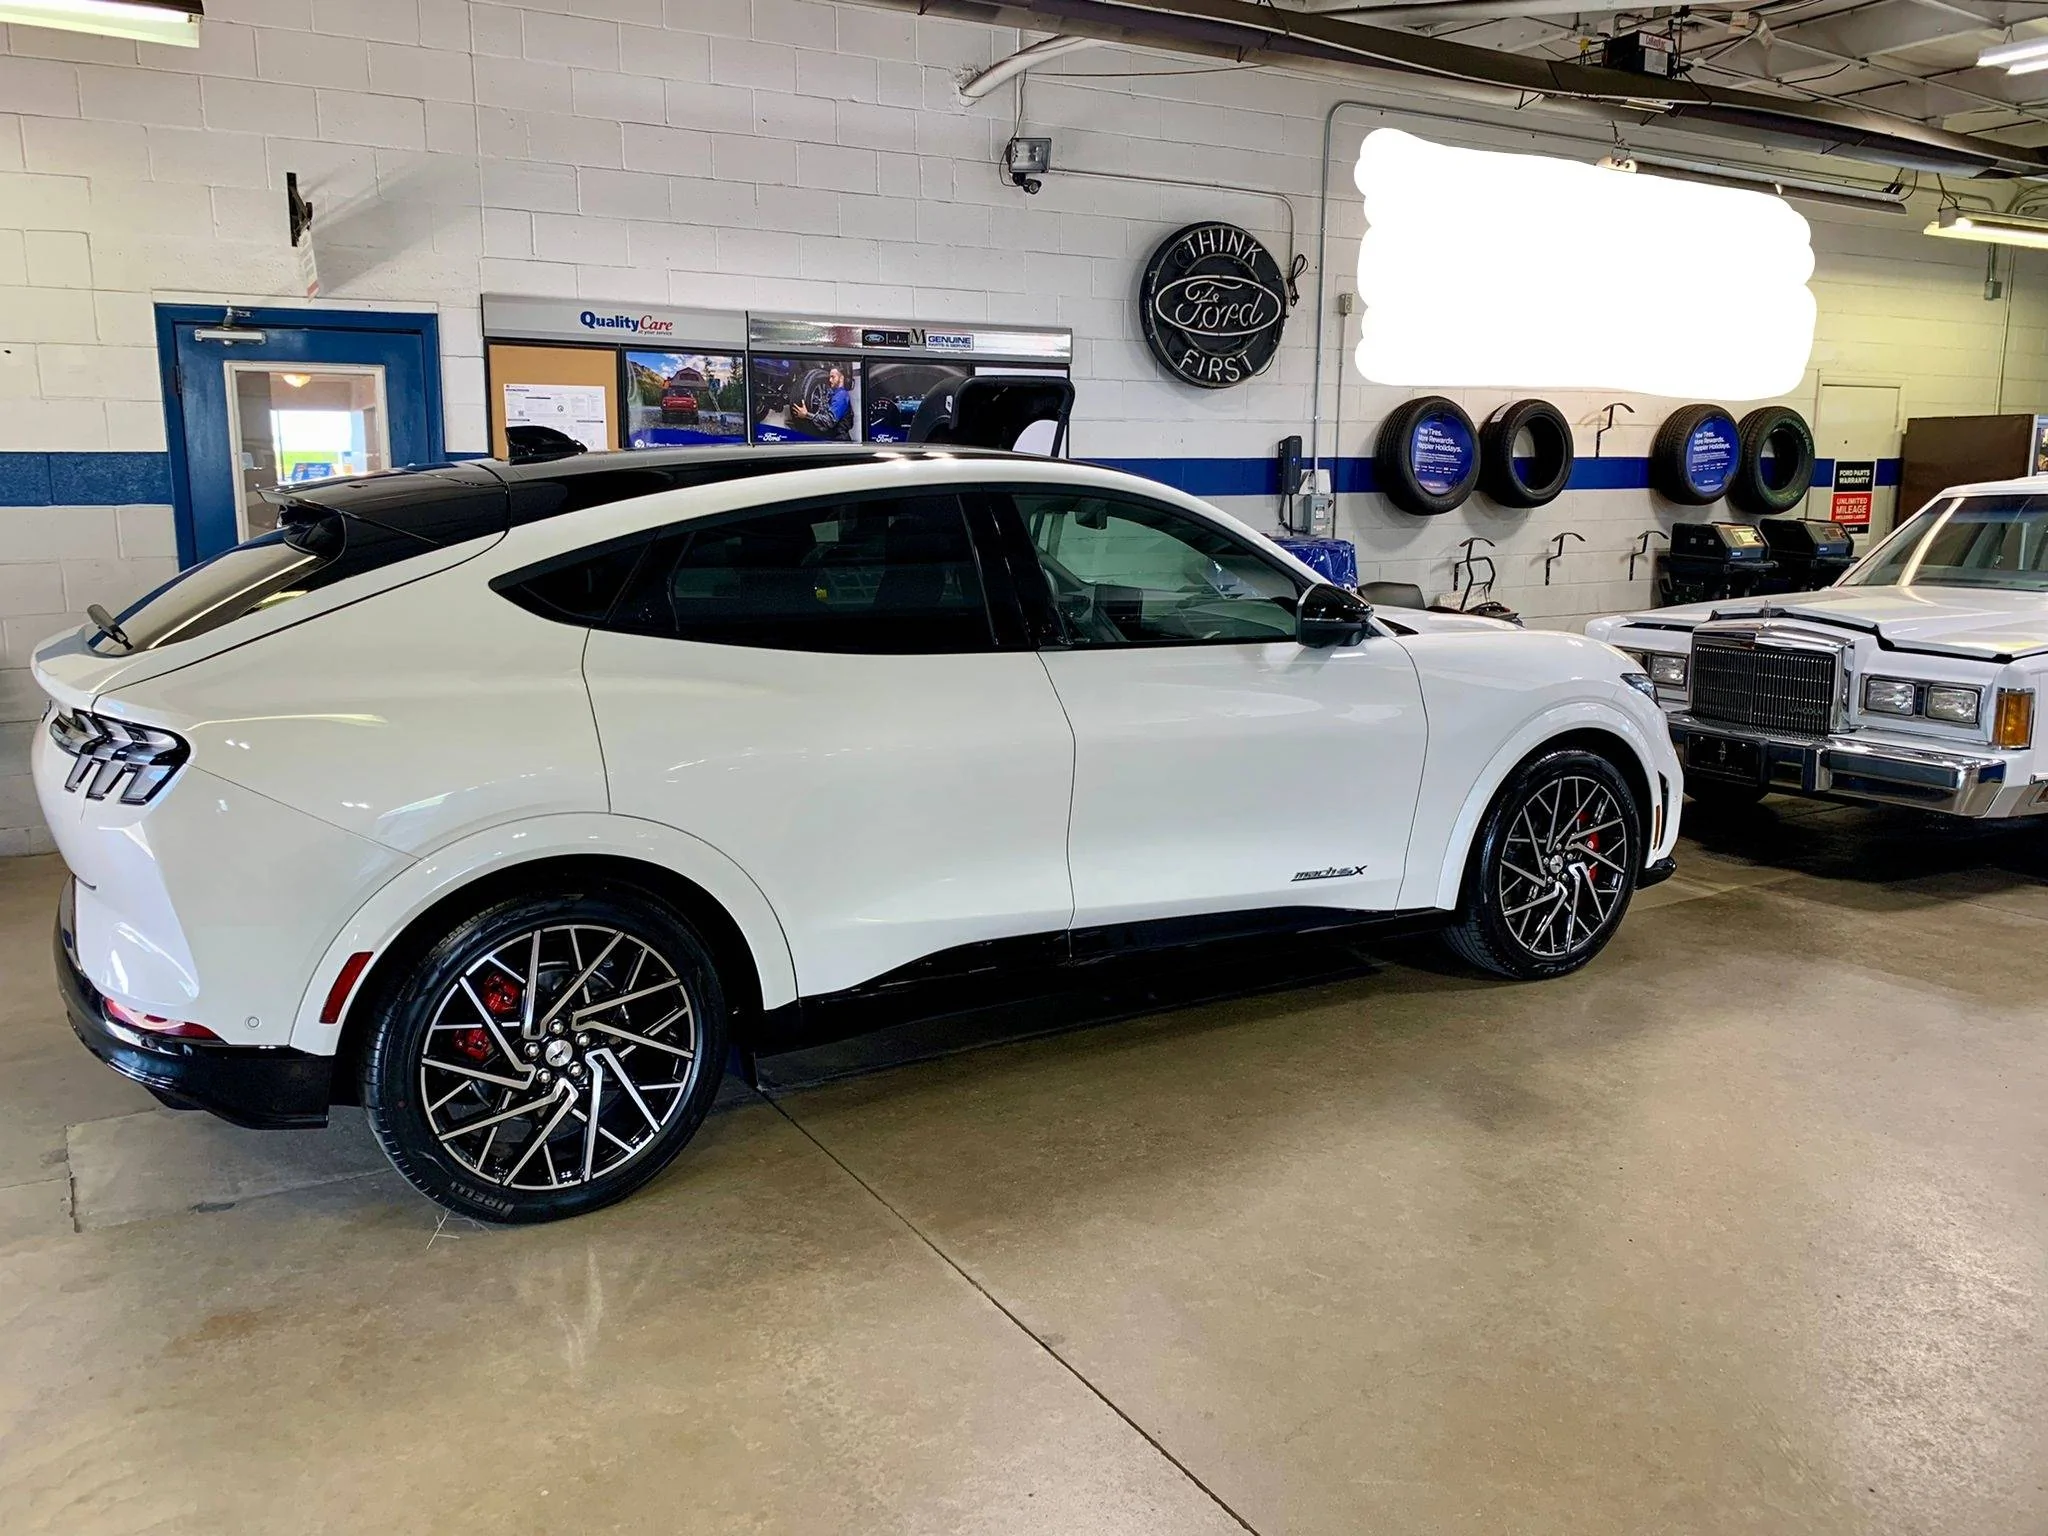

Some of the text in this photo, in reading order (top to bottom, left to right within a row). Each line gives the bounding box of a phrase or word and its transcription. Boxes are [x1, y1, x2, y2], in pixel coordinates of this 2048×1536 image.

[1182, 228, 1263, 266] THINK
[1174, 280, 1264, 329] Ford
[928, 335, 971, 344] GENUINE
[1179, 349, 1253, 382] FIRST
[763, 432, 782, 442] Ford
[876, 432, 894, 443] Ford
[1836, 497, 1868, 505] UNLIMITED
[1836, 505, 1867, 515] MILEAGE
